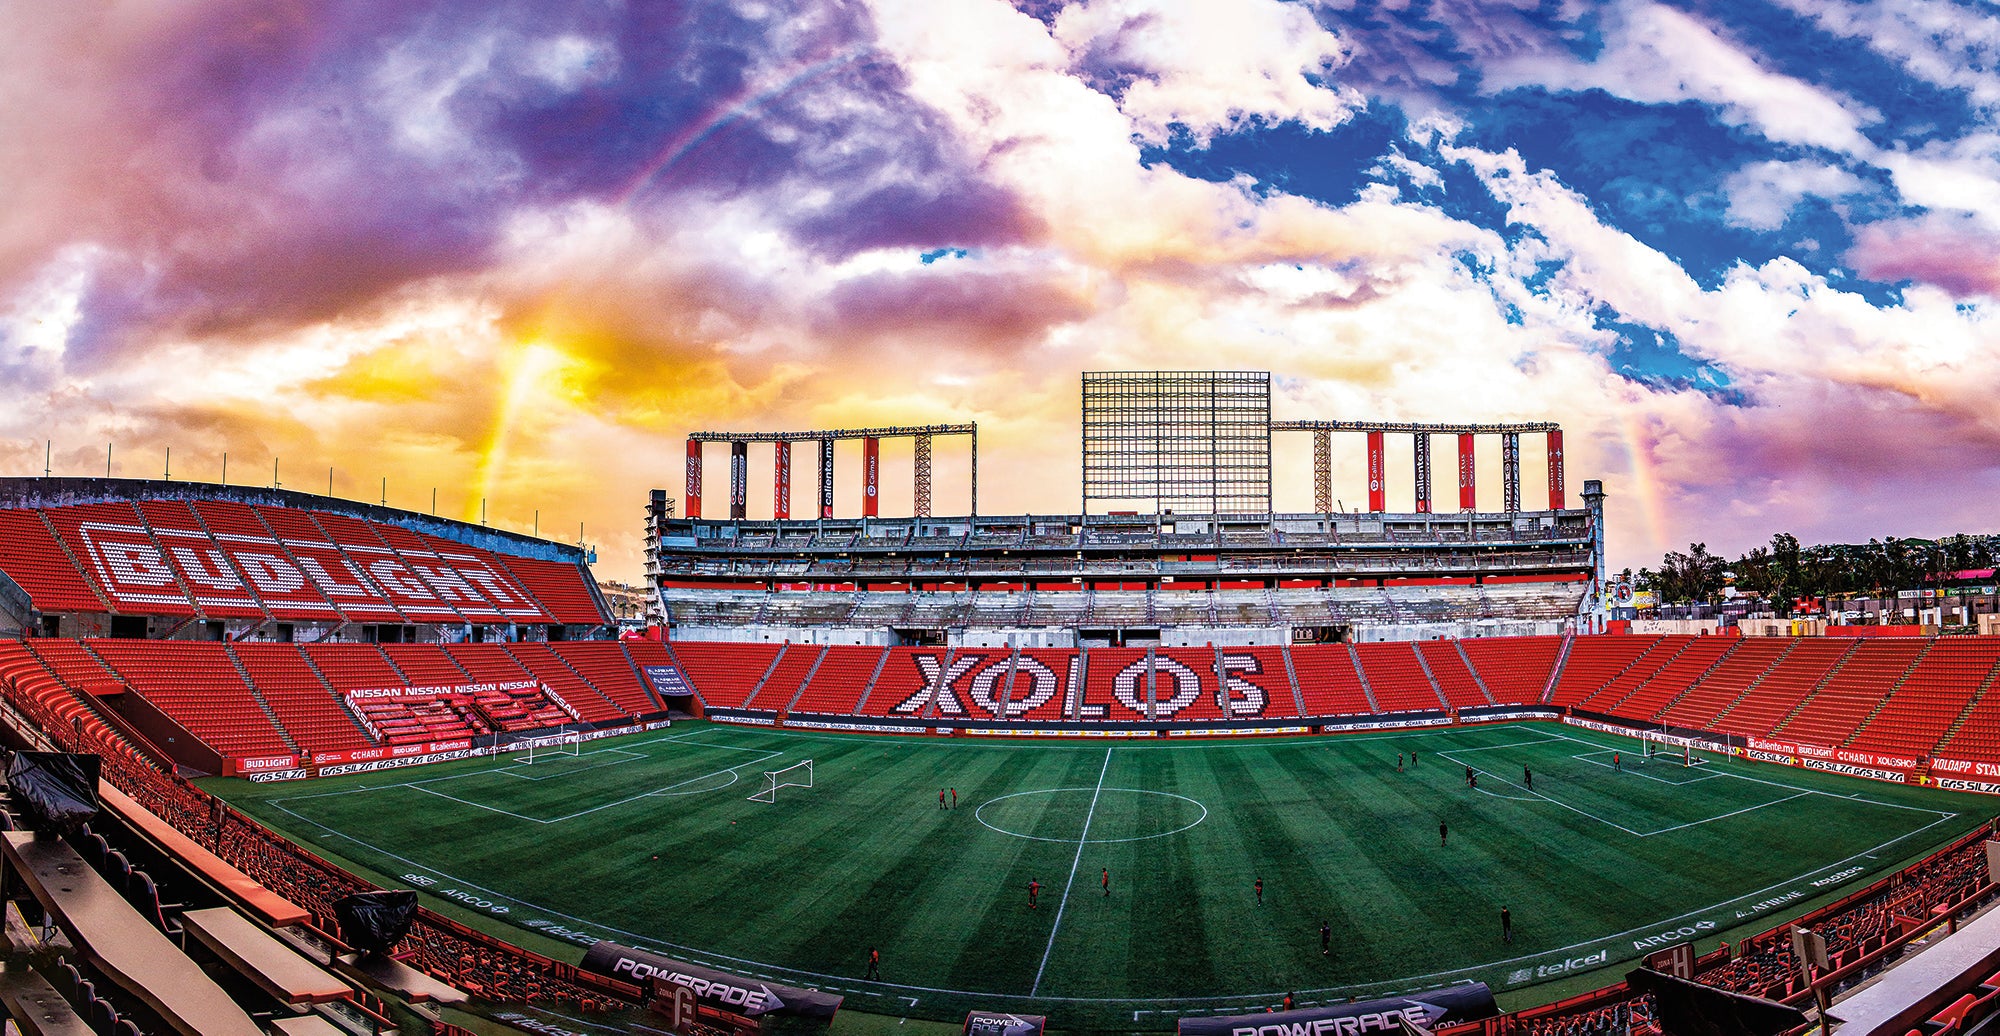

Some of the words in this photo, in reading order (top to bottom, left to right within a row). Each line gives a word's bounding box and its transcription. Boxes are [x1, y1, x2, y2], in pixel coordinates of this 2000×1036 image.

[824, 440, 832, 506] caliente.mx
[1417, 433, 1425, 500] caliente.mx
[350, 688, 401, 699] NISSAN
[405, 685, 451, 696] NISSAN
[454, 683, 497, 694] NISSAN
[499, 680, 537, 690] NISSAN
[893, 653, 1268, 717] XOLOS
[541, 683, 581, 721] NISSAN
[344, 695, 382, 742] NISSAN
[356, 749, 384, 759] CHARLY
[435, 741, 469, 751] caliente.mx
[1749, 750, 1766, 760] GAS
[1754, 739, 1795, 754] caliente.mx
[1799, 745, 1813, 755] BUD
[1813, 748, 1833, 757] LIGHT
[246, 760, 265, 768] BUD
[265, 758, 291, 767] LIGHT
[321, 766, 343, 775] GAS
[377, 758, 396, 769] GAS
[427, 752, 445, 762] GAS
[1806, 759, 1824, 769] GAS
[1853, 767, 1873, 777] GAS
[1844, 752, 1873, 765] CHARLY
[1931, 758, 1972, 773] XOLOAPP
[251, 773, 272, 782] GAS
[1941, 779, 1965, 789] GAS
[440, 888, 493, 909] ARCO
[1752, 890, 1805, 912] AFIRME
[1633, 927, 1696, 950] ARCO
[1537, 950, 1607, 977] telcel
[1672, 946, 1689, 979] H
[613, 957, 768, 1011] POWERADE
[973, 1017, 1023, 1027] POWER
